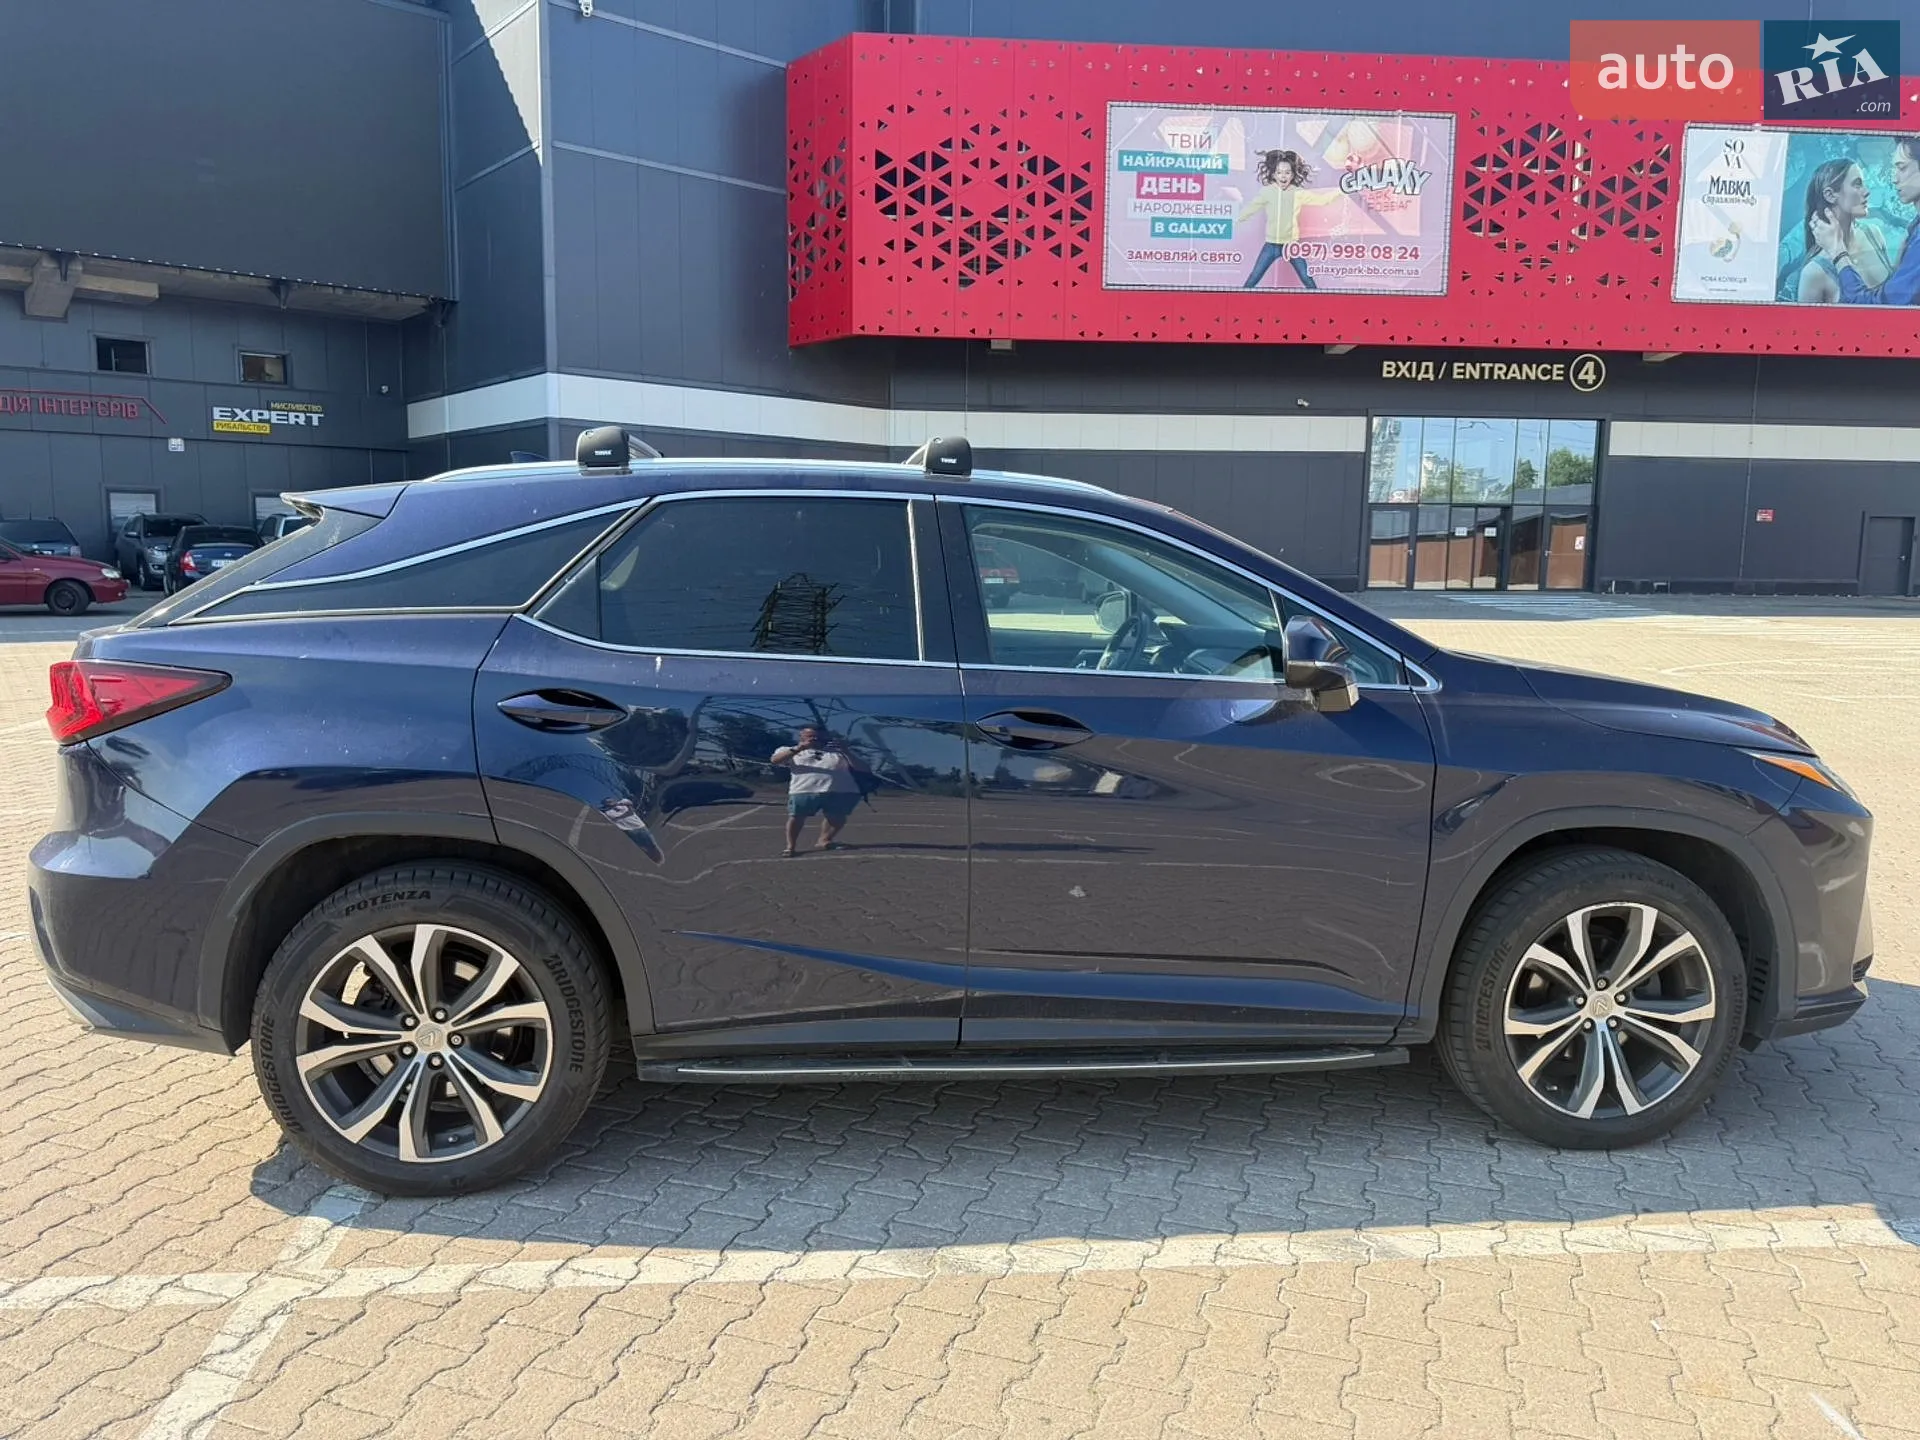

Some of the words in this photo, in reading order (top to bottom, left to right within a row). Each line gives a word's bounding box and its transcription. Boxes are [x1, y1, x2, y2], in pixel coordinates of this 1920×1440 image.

[1167, 131, 1213, 150] ТВІЙ
[1122, 153, 1223, 170] НАЙКРАЩИЙ
[1140, 176, 1202, 195] ДЕНЬ
[1340, 158, 1432, 195] GALAXY
[1133, 202, 1232, 215] НАРОДЖЕННЯ
[1154, 222, 1165, 233] В
[1168, 222, 1227, 235] GALAXY
[1127, 249, 1197, 262] ЗАМОВЛЯЙ
[1200, 251, 1242, 263] СВЯТО
[1284, 243, 1328, 260] (097)
[1333, 245, 1366, 259] 998
[1371, 246, 1393, 260] 08
[1398, 246, 1420, 260] 24
[1308, 265, 1420, 277] galaxypark-bb.com.ua
[1382, 361, 1435, 381] ВХІД
[1452, 362, 1565, 381] ENTRANCE
[1577, 361, 1597, 385] 4
[212, 406, 324, 426] EXPERT
[215, 422, 268, 432] РИБАЛЬСТВО
[345, 890, 431, 916] POTENZA
[542, 953, 586, 1073] BRIDGESTONE
[260, 1014, 305, 1134] BRIDGESTONE
